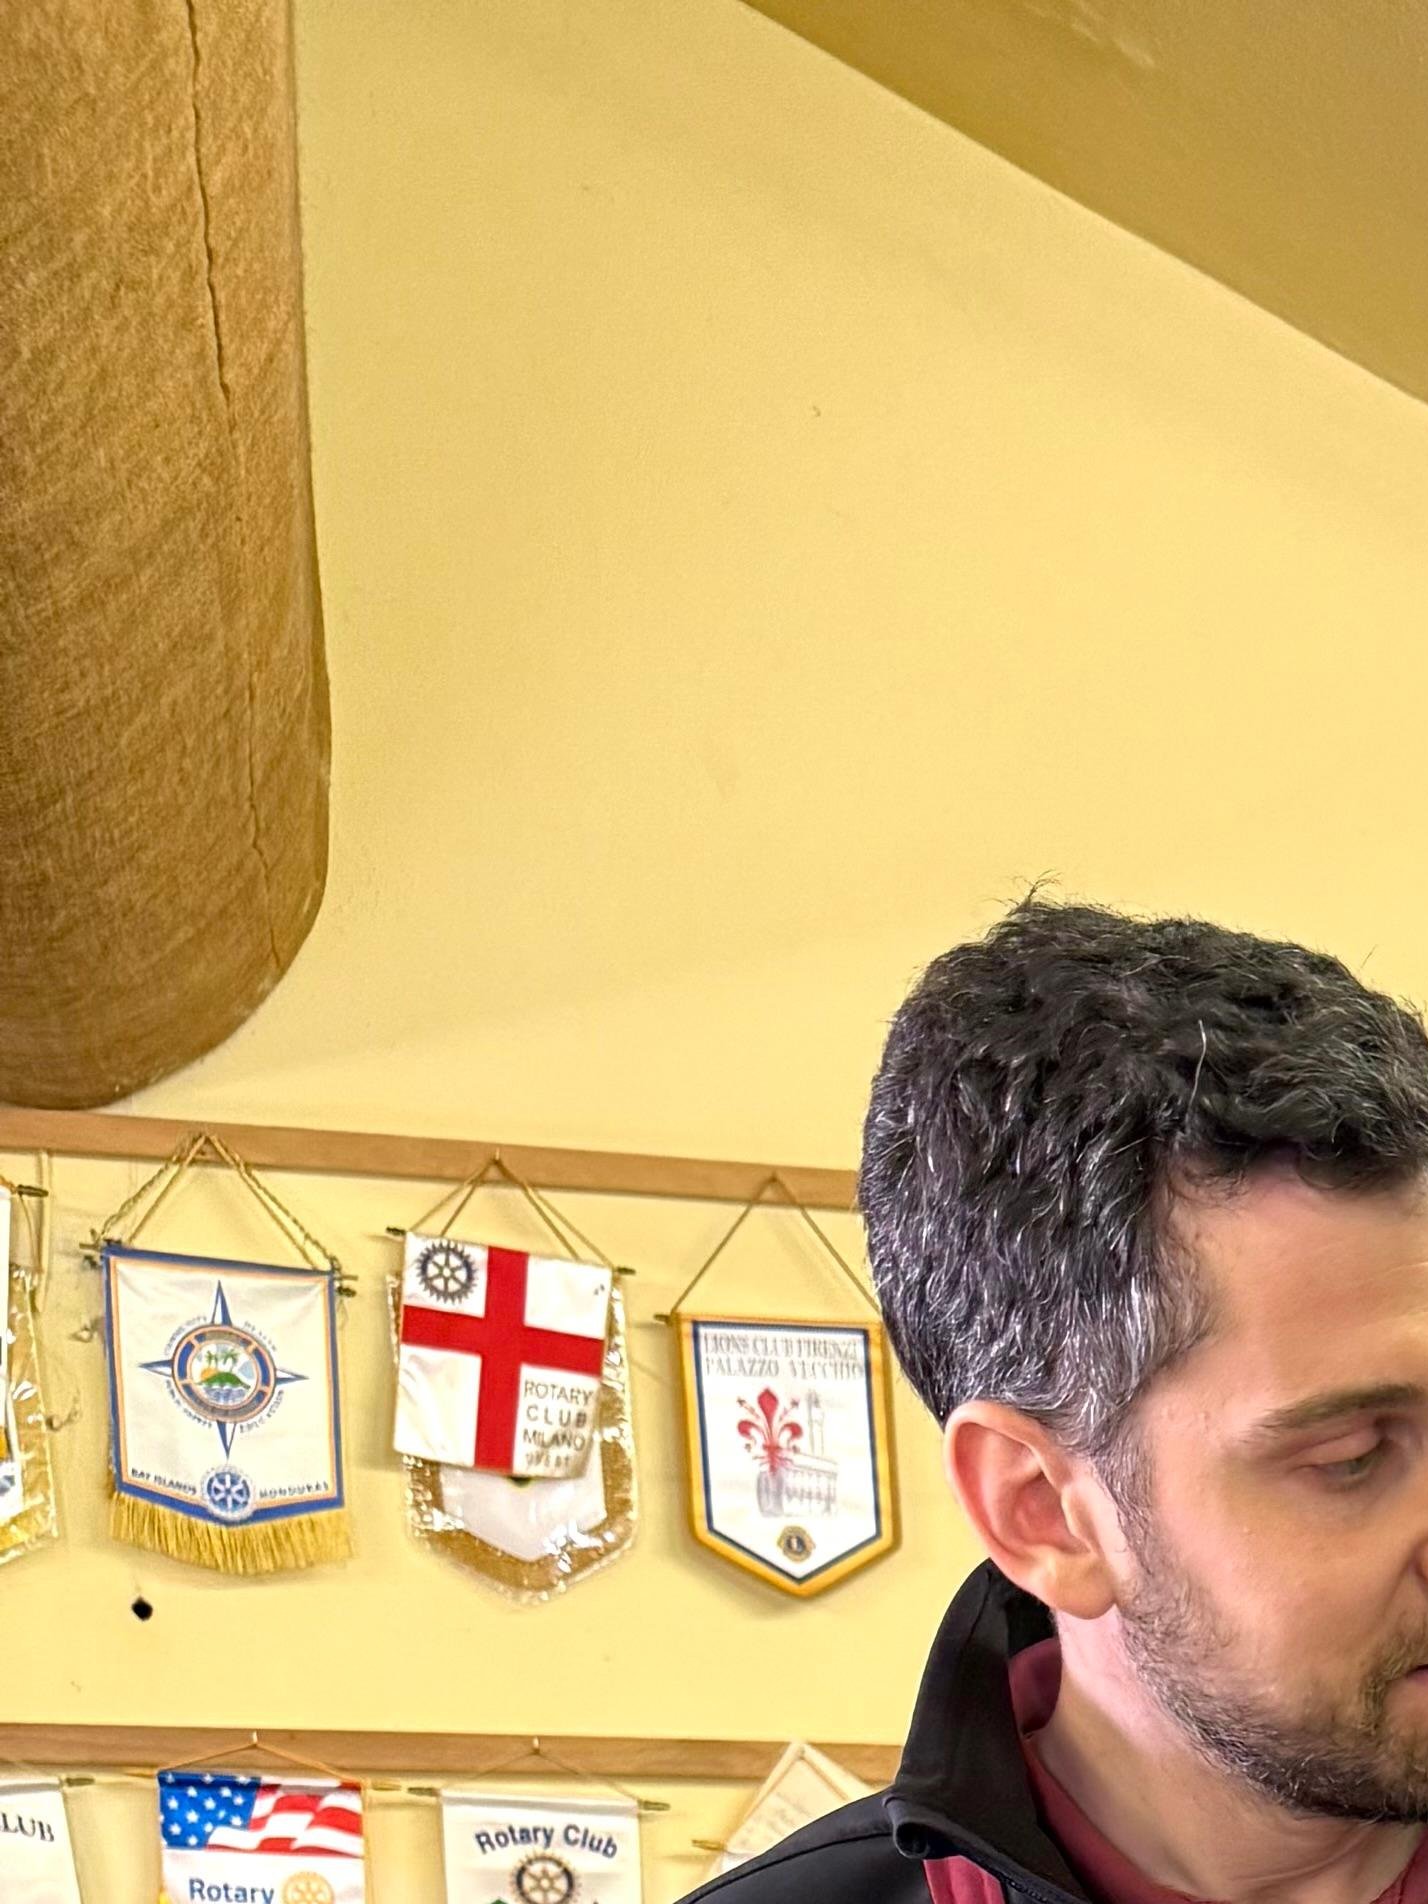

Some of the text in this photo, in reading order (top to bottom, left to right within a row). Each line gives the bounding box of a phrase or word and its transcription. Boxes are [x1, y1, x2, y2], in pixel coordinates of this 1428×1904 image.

[524, 1379, 594, 1406] ROTARY
[526, 1406, 588, 1429] CLUB
[523, 1429, 586, 1451] MILANO
[475, 1824, 618, 1859] Rotary Club
